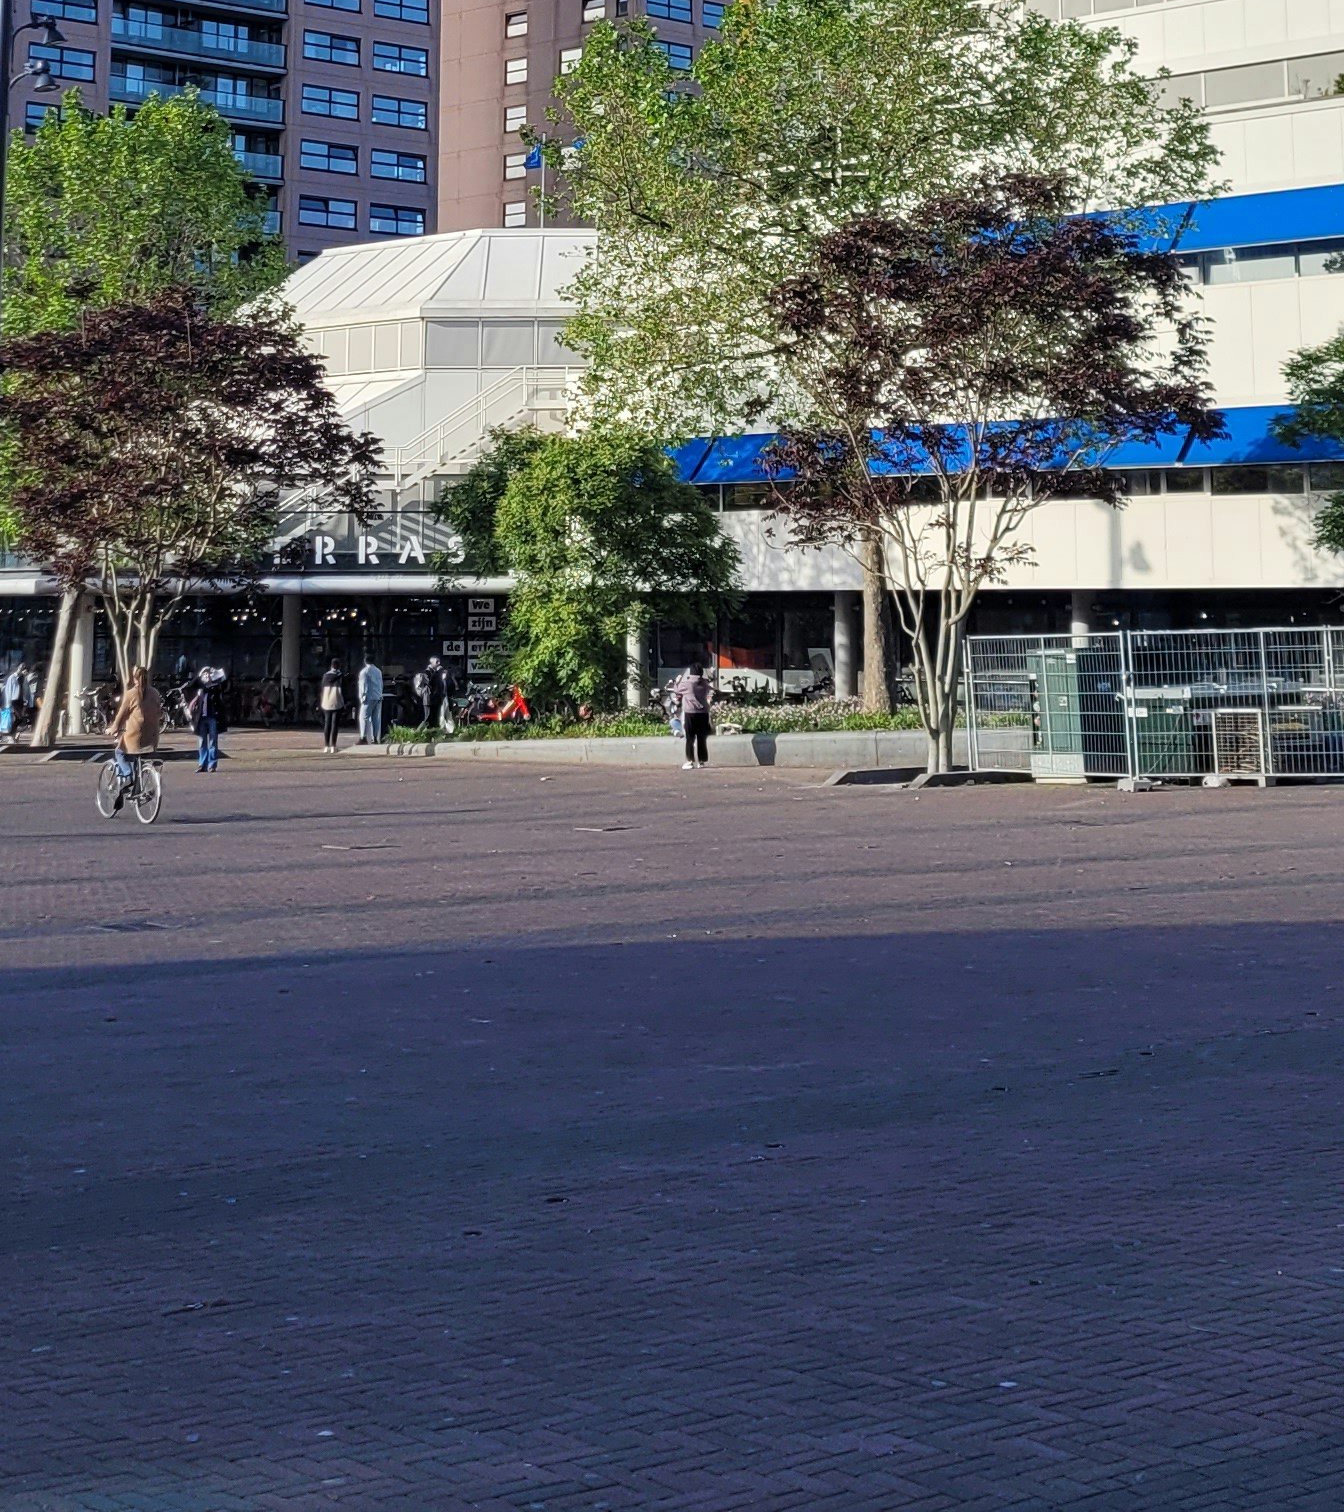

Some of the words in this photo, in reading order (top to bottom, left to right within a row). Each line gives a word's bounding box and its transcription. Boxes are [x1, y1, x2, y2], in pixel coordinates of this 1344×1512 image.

[472, 600, 491, 610] We
[471, 618, 493, 630] zijn
[446, 641, 461, 652] de
